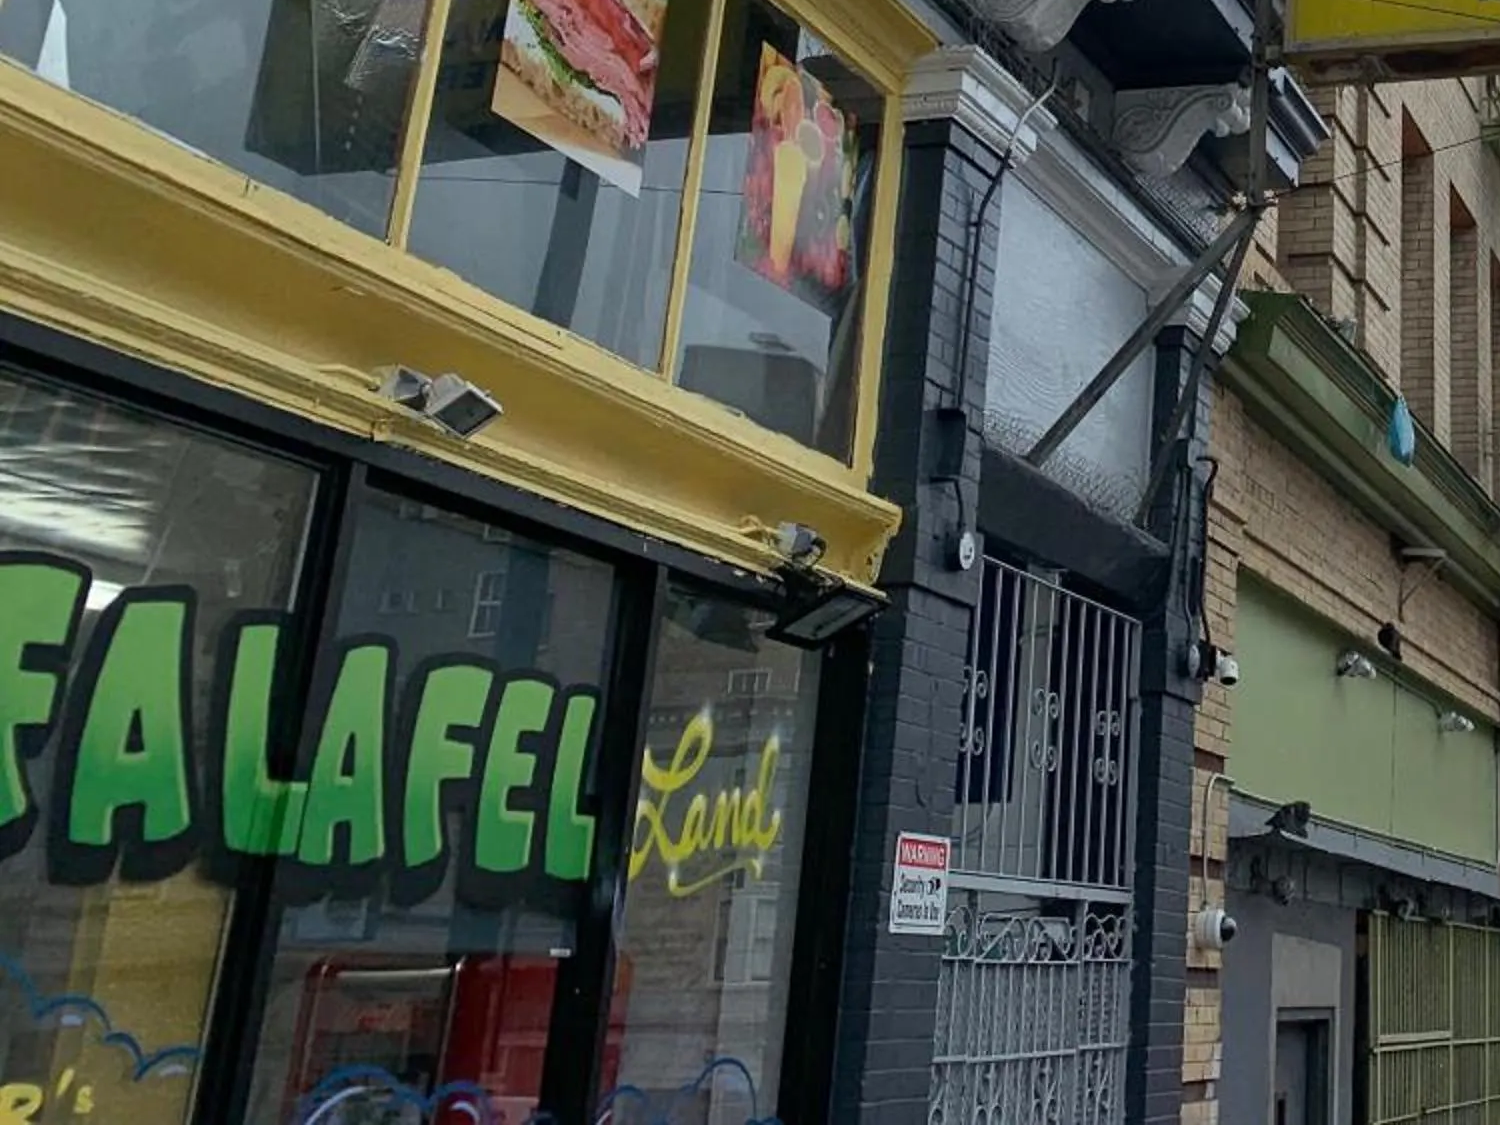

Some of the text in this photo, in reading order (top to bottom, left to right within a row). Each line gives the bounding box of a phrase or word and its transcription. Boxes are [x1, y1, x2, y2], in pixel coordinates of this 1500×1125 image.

[0, 563, 597, 882] FALAFEL
[628, 708, 781, 880] Land
[901, 841, 945, 866] WARNING
